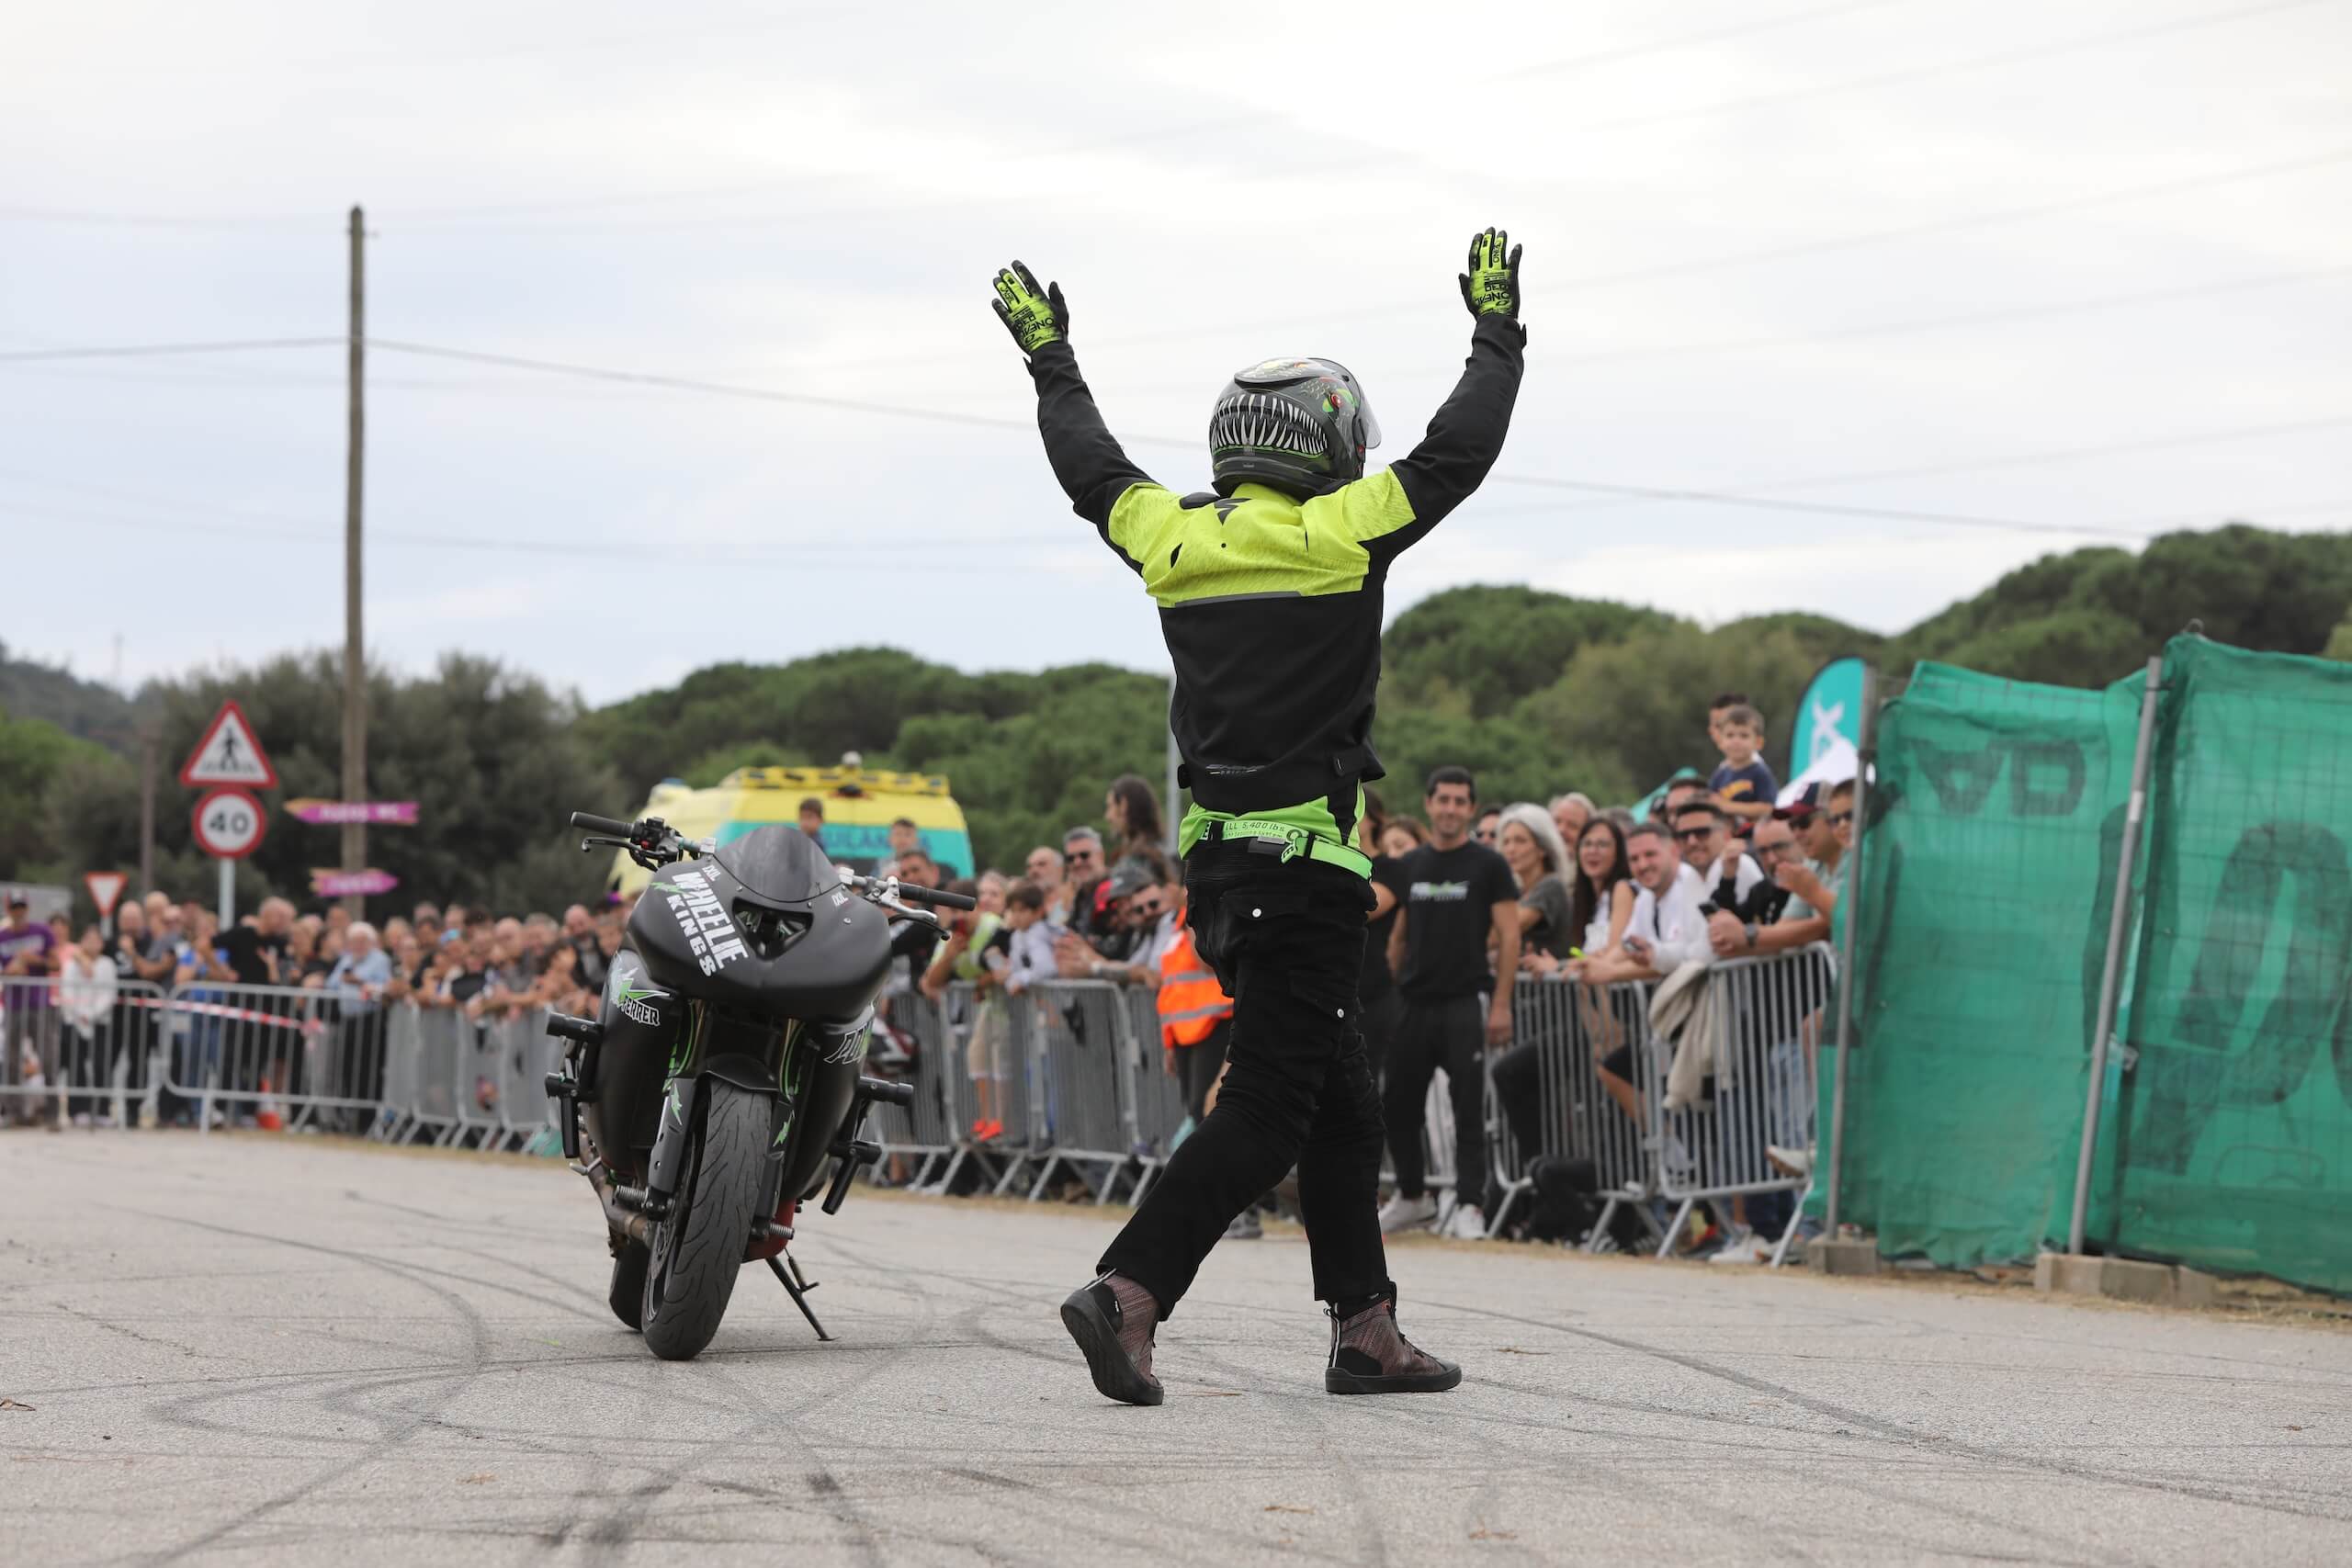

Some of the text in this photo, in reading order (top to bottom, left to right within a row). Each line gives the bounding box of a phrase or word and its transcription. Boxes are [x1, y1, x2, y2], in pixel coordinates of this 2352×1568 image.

[209, 811, 249, 835] 40
[666, 894, 717, 976] KINGS
[672, 871, 749, 970] WHEELIE
